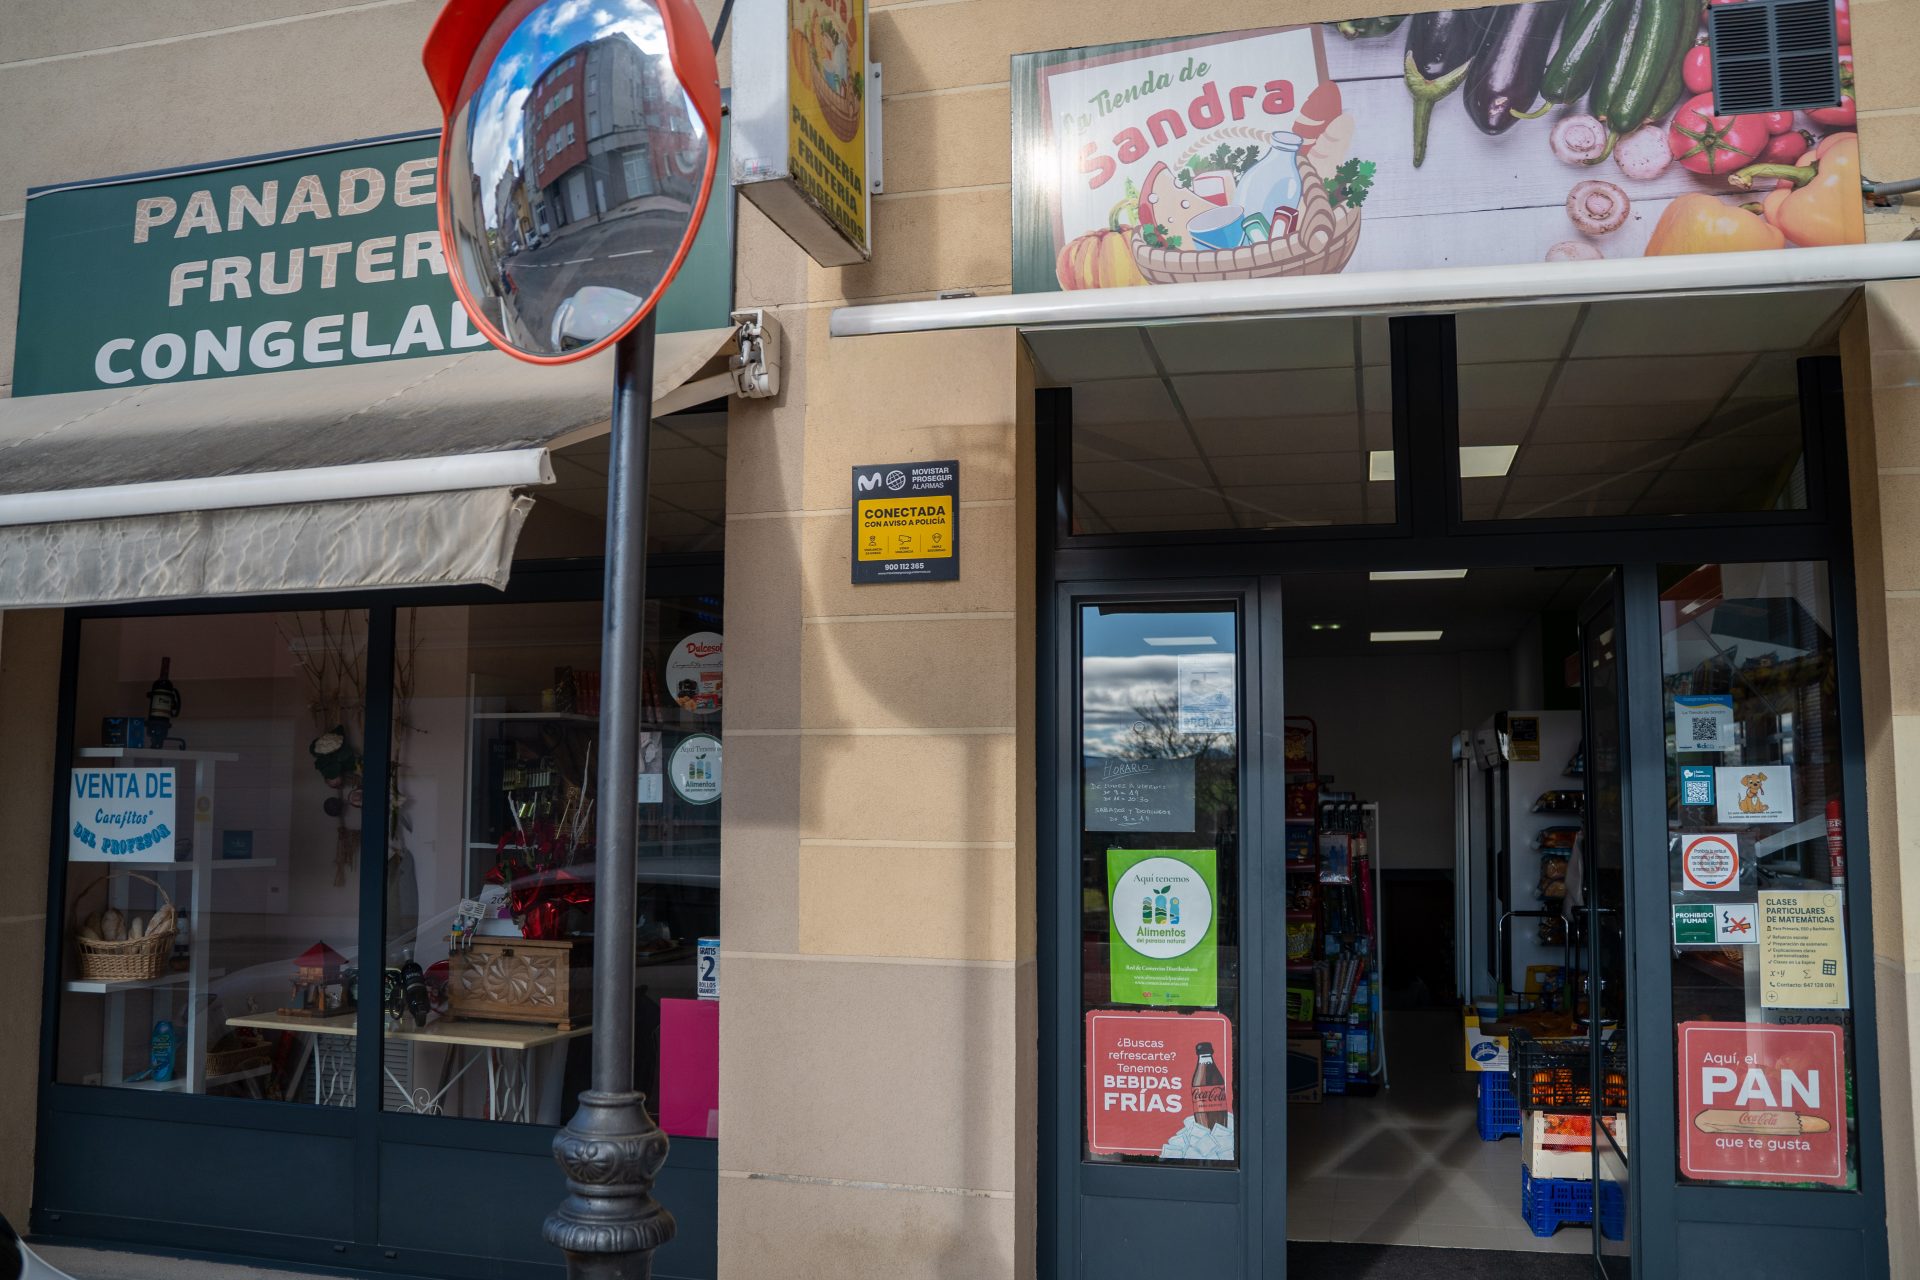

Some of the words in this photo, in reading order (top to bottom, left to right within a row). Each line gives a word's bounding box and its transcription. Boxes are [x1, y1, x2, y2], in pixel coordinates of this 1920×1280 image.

[1088, 70, 1174, 117] Tienda
[1179, 56, 1212, 83] de
[1078, 78, 1296, 190] Sandra
[792, 104, 863, 197] PANADERÍA
[798, 137, 859, 216] FRUTERÍA
[791, 155, 866, 243] CONGELADOS
[911, 467, 950, 475] MOVISTAR
[911, 474, 953, 483] PROSEGUR
[911, 482, 945, 490] ALARMAS
[864, 506, 946, 519] CONECTADA
[883, 519, 907, 527] AVISO
[915, 517, 946, 525] POLICÍA
[884, 563, 899, 571] 900
[686, 640, 723, 655] Dulcesol
[74, 772, 140, 799] VENTA
[145, 772, 173, 799] DE
[73, 821, 97, 849] DEL
[101, 823, 171, 855] PROFESOR
[1133, 873, 1154, 885] Aquí
[1766, 898, 1797, 906] CLASES
[1766, 907, 1826, 915] PARTICULARES
[1778, 915, 1835, 923] MATEMÁTICAS
[1136, 925, 1186, 937] Alimentos
[699, 947, 716, 955] GRATIS
[1117, 1038, 1164, 1048] ¿Buscas
[1108, 1051, 1176, 1061] refrescarte?
[1703, 1052, 1740, 1065] Aquí,
[1744, 1052, 1758, 1064] el
[1117, 1064, 1168, 1074] Tenemos
[1103, 1075, 1182, 1090] BEBIDAS
[1701, 1067, 1821, 1109] PAN
[1103, 1089, 1183, 1113] FRÍAS
[1715, 1138, 1743, 1150] que
[1748, 1137, 1763, 1148] te
[1768, 1138, 1811, 1151] gusta
